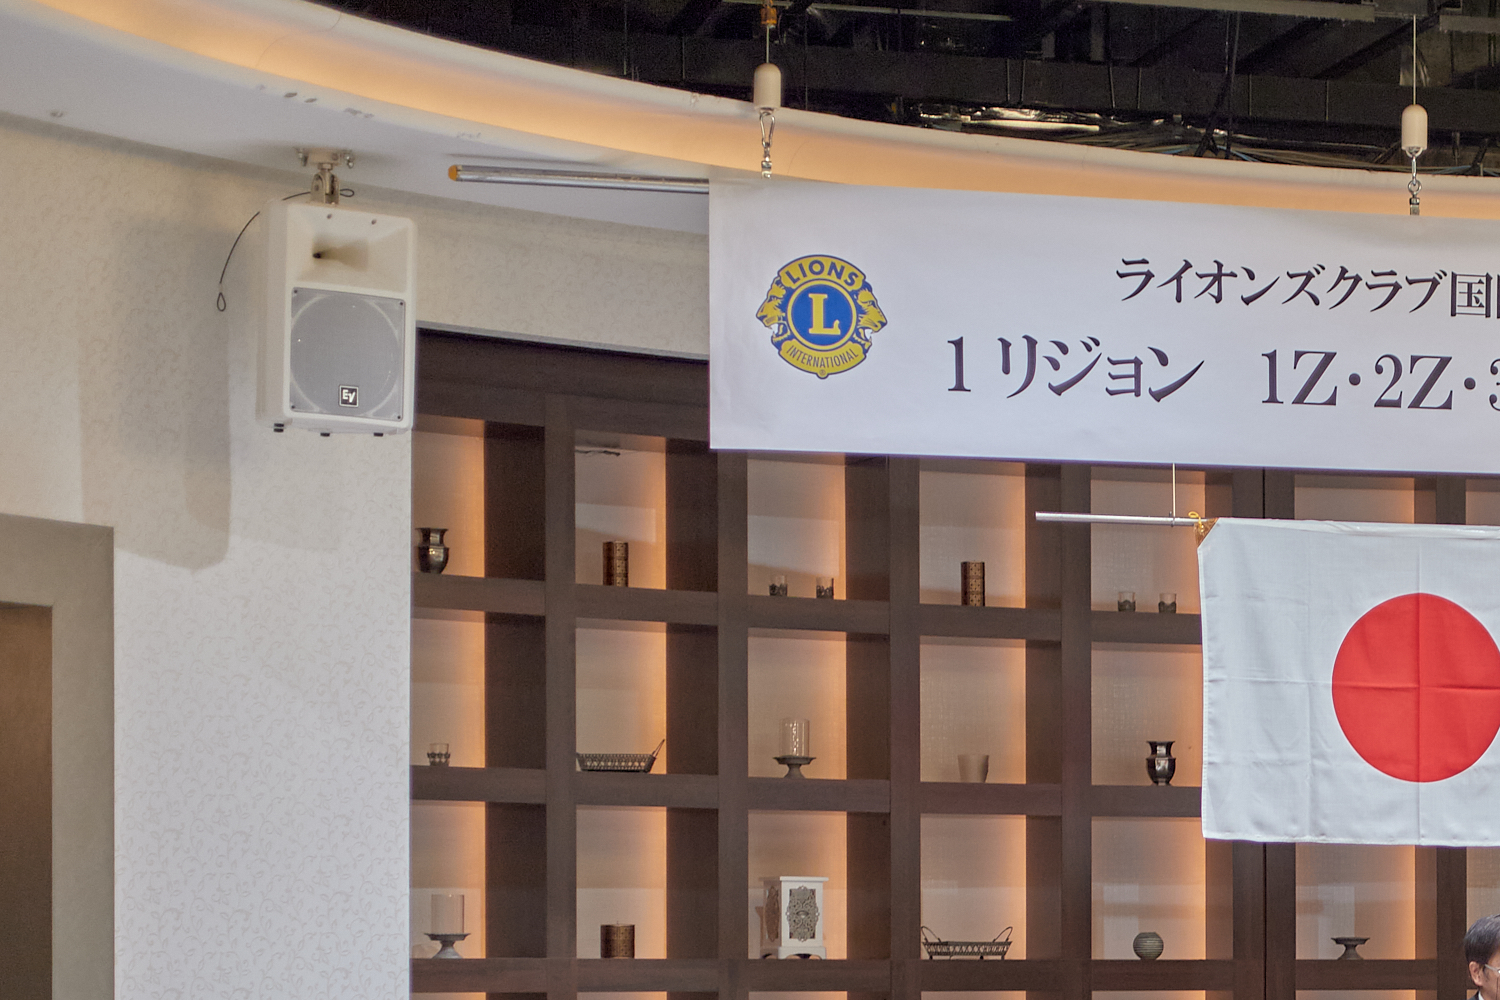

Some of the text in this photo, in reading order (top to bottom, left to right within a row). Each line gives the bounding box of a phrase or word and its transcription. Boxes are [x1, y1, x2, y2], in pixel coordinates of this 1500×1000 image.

[785, 260, 859, 287] LIONS
[809, 293, 841, 335] L
[786, 345, 859, 369] INTERNATIONAL
